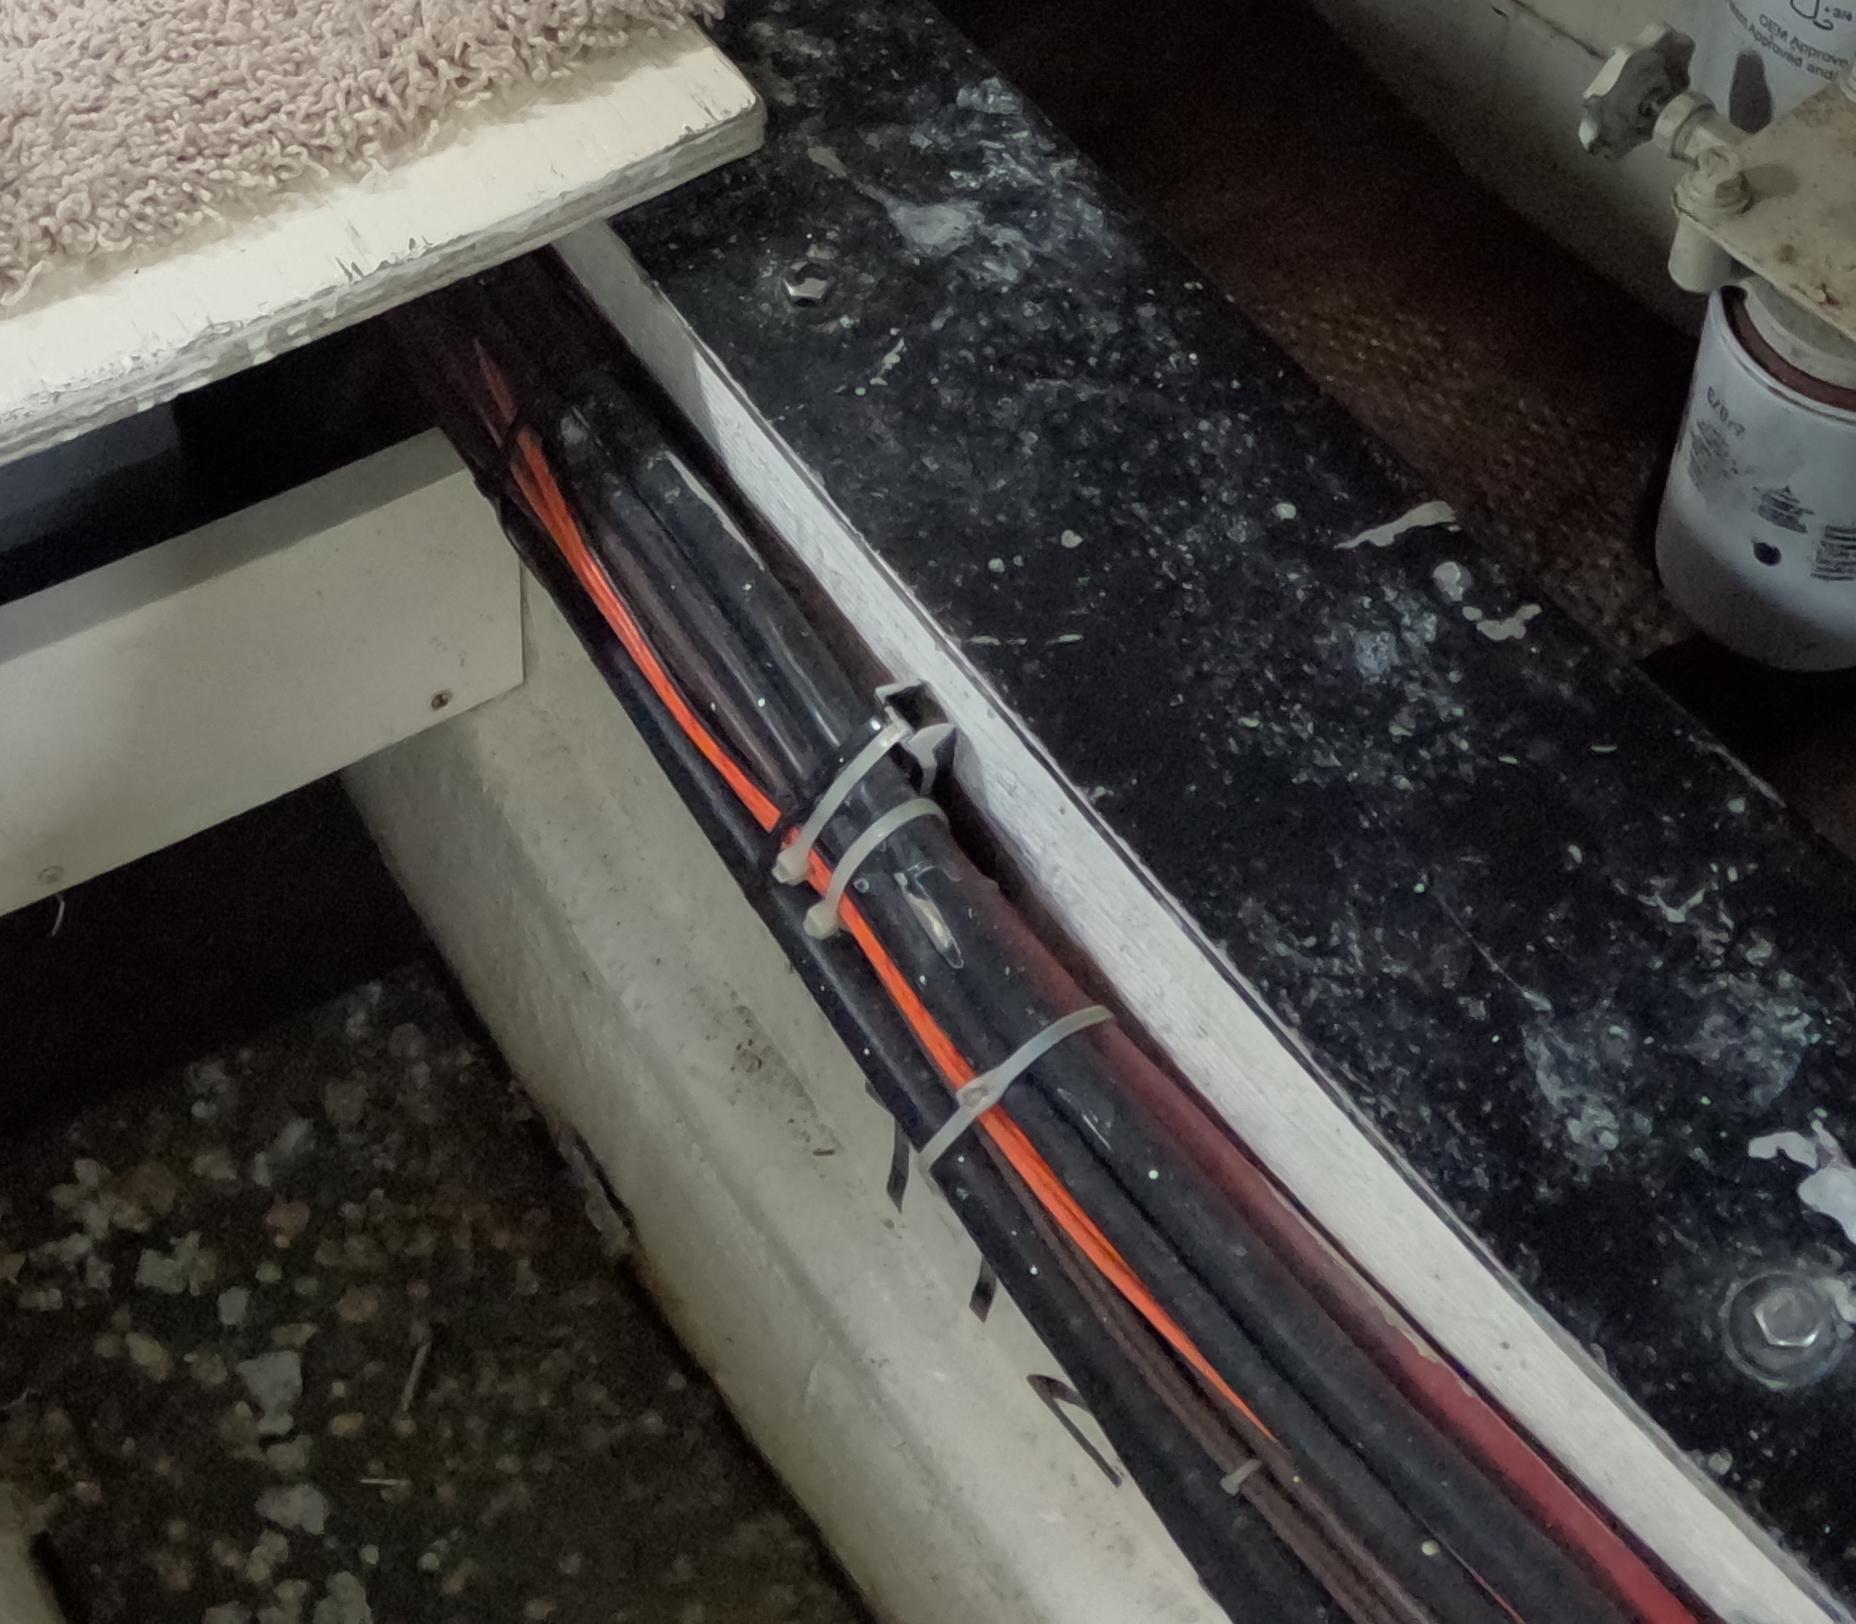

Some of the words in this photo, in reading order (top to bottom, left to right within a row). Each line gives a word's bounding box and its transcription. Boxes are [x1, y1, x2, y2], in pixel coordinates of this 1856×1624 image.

[1748, 23, 1803, 68] Approved
[1759, 13, 1788, 42] OEM
[1790, 36, 1850, 68] Approve
